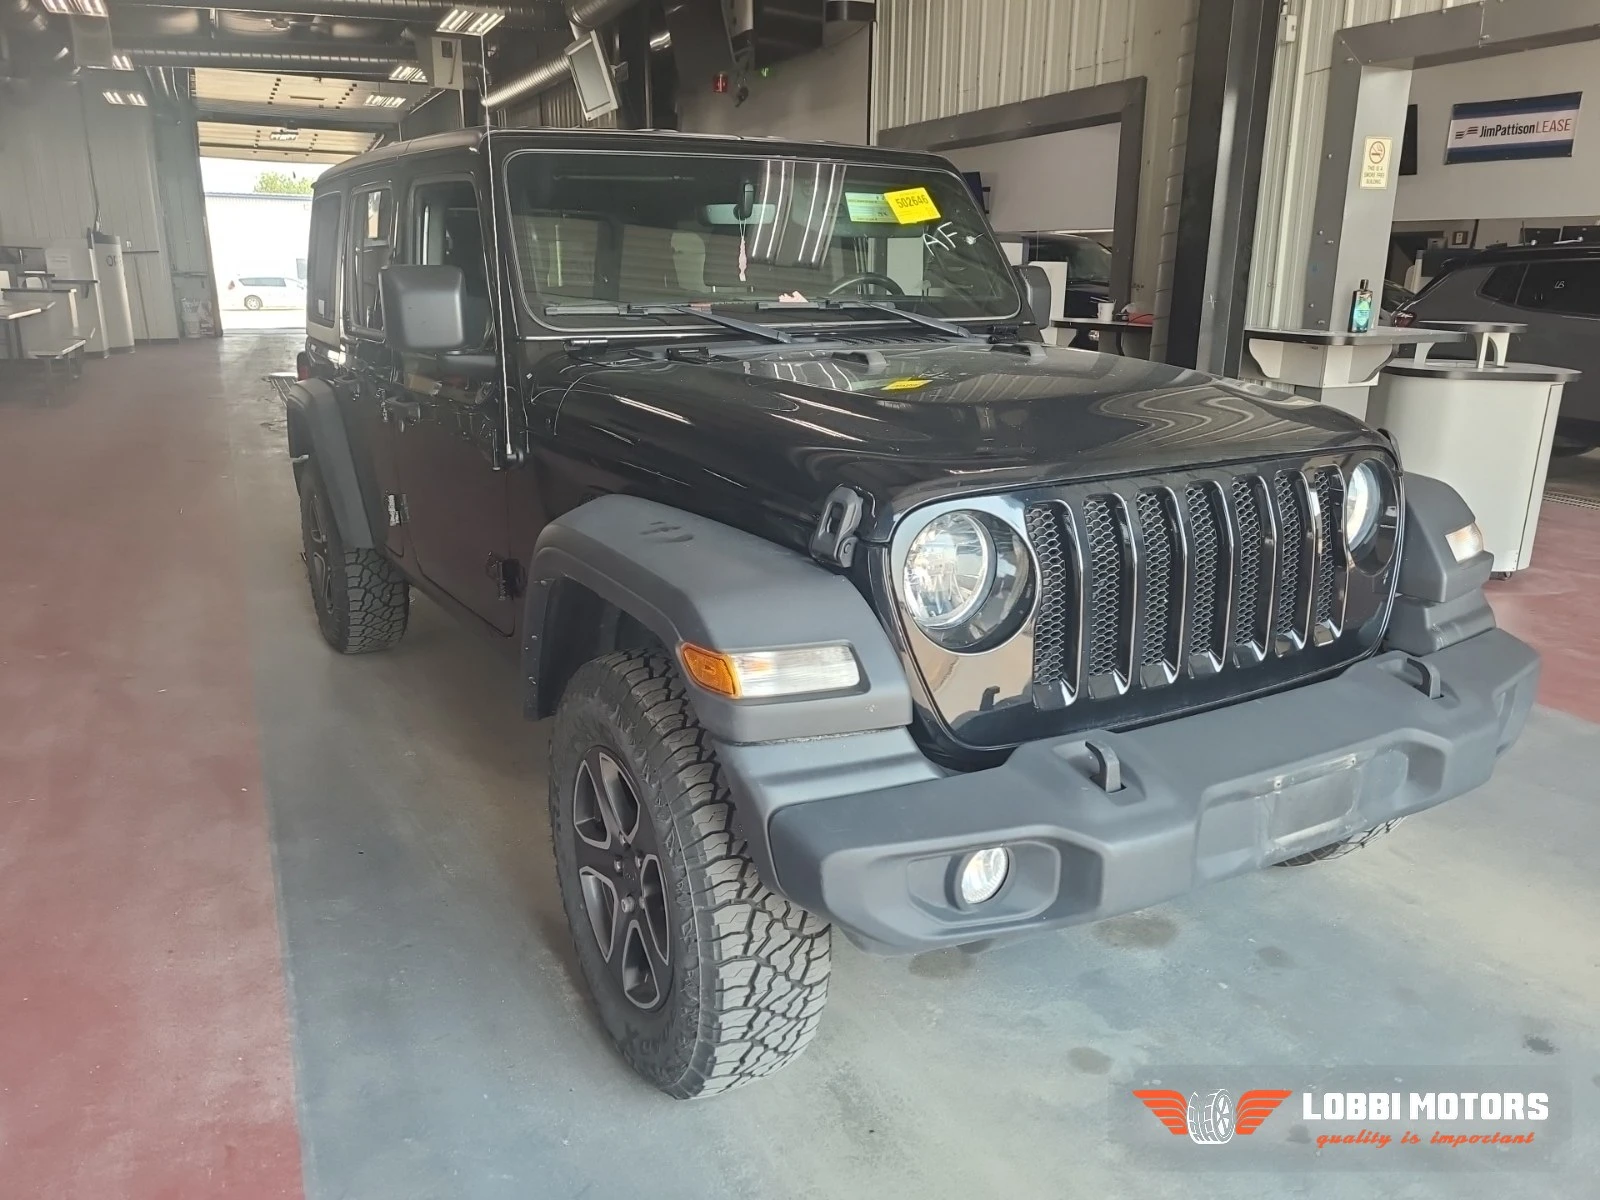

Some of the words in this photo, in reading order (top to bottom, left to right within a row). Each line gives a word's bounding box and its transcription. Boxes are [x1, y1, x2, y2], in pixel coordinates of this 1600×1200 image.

[1479, 118, 1572, 138] JimPattisonLEASE
[895, 195, 929, 208] 502646
[923, 221, 958, 256] AF
